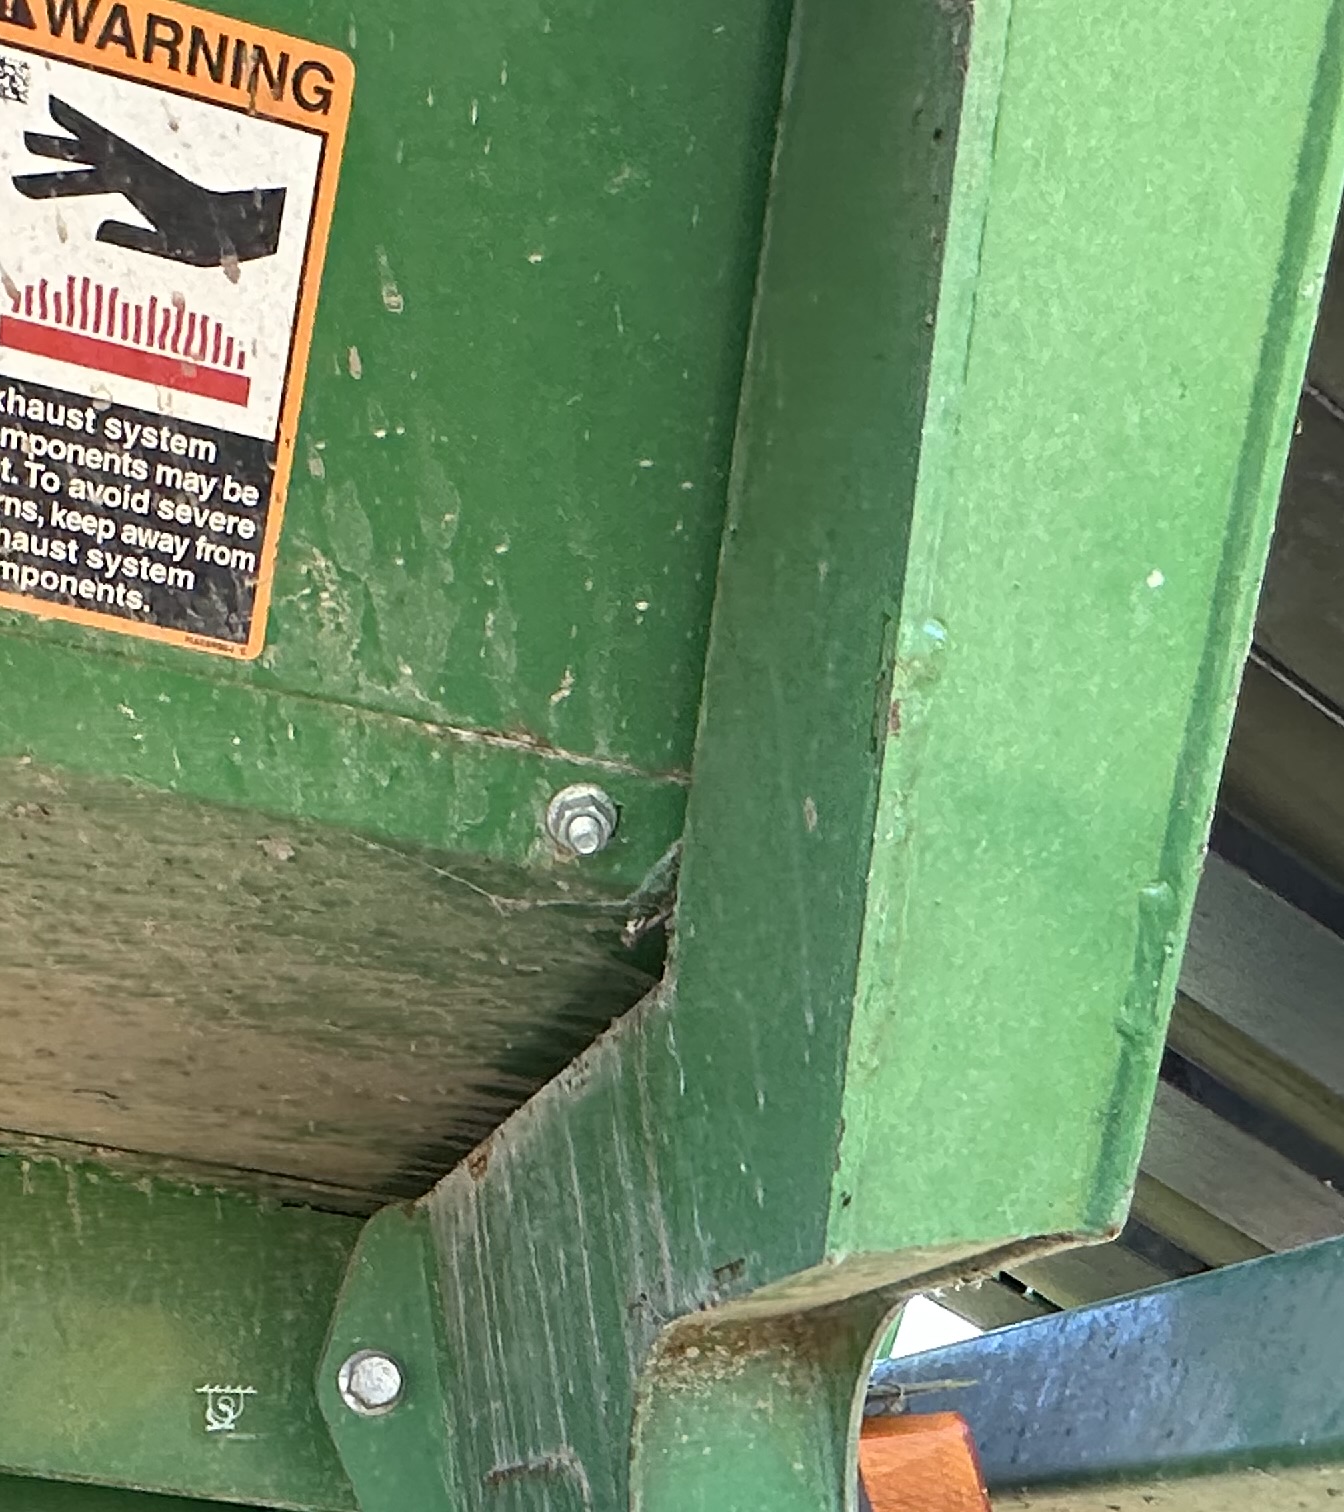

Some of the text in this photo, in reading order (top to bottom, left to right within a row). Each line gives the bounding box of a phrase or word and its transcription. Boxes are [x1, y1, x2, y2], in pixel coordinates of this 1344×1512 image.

[44, 0, 334, 116] WARNING
[104, 416, 218, 463] system
[24, 460, 61, 493] To
[68, 477, 151, 515] avoid
[157, 498, 256, 540] severe
[155, 463, 219, 502] may
[222, 473, 260, 506] be
[50, 500, 116, 544] keep
[120, 523, 191, 562] away
[195, 535, 256, 573] from
[85, 548, 196, 590] system
